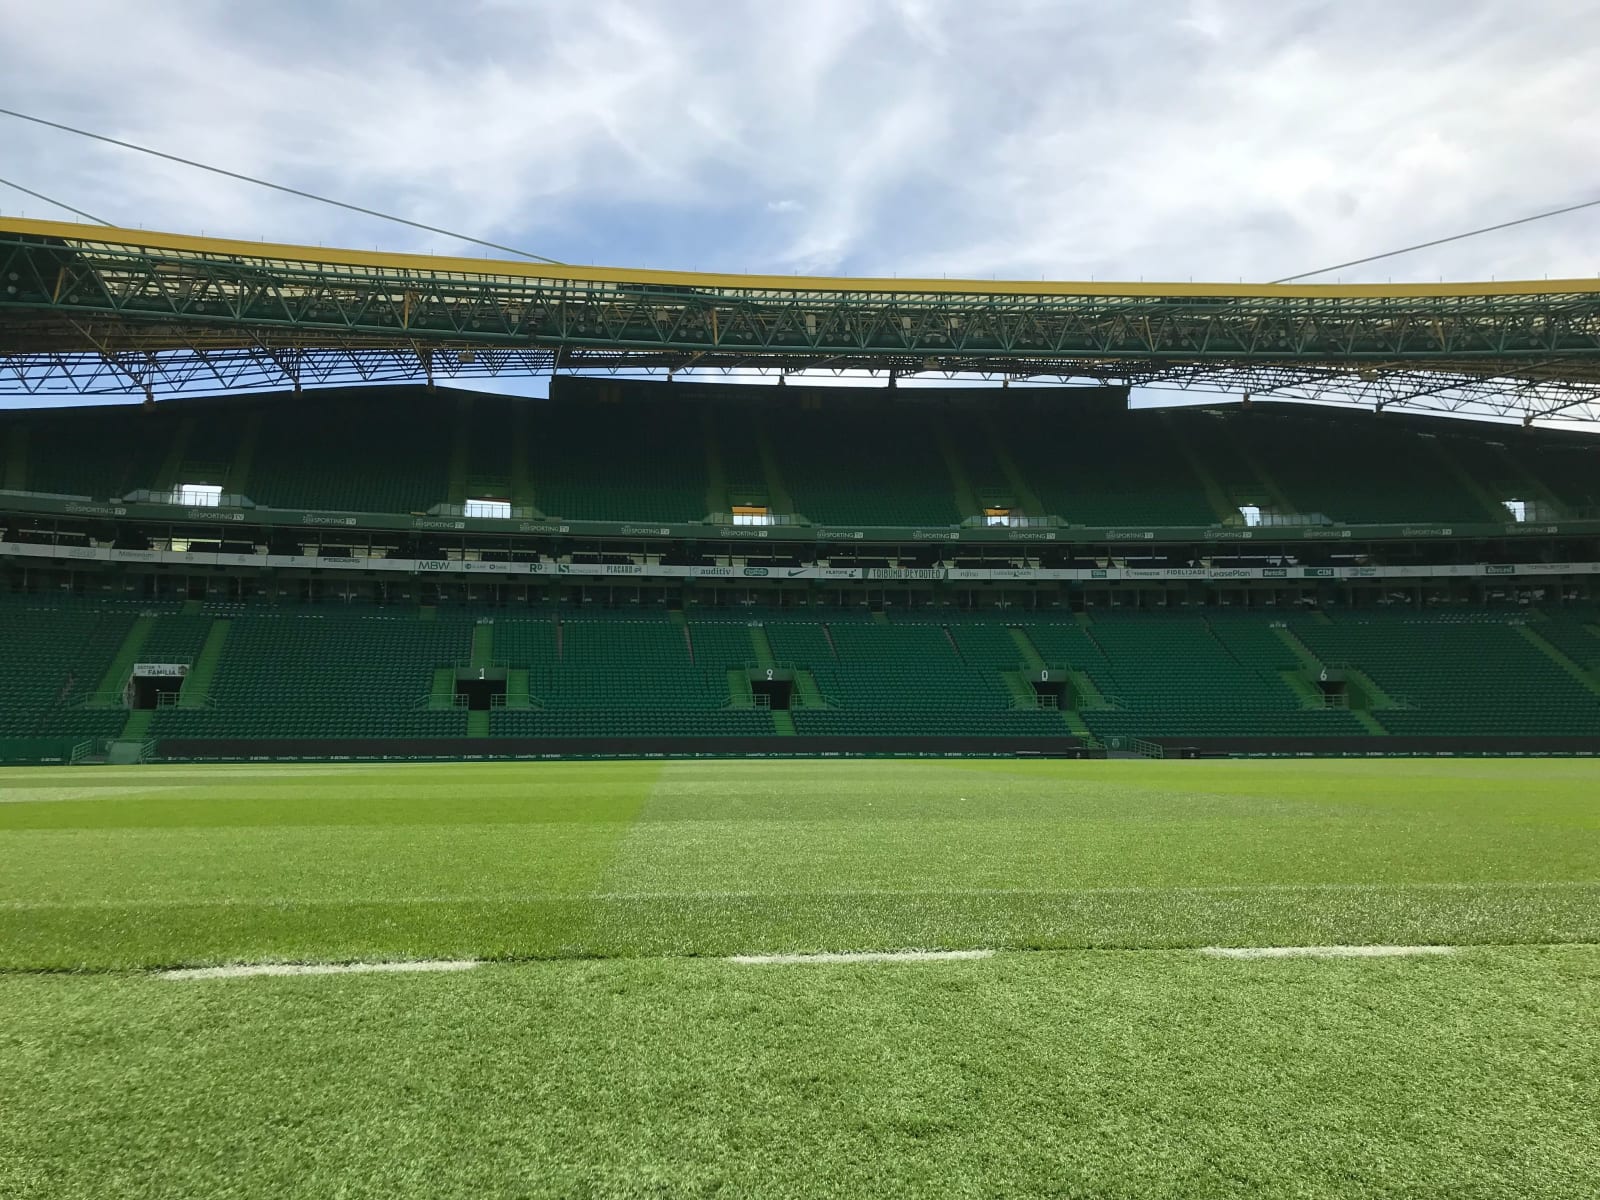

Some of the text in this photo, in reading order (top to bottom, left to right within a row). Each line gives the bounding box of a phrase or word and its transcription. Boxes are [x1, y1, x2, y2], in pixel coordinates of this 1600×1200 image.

[418, 561, 450, 570] MBW
[700, 567, 731, 575] auditiv
[1209, 569, 1251, 578] LeasePlan
